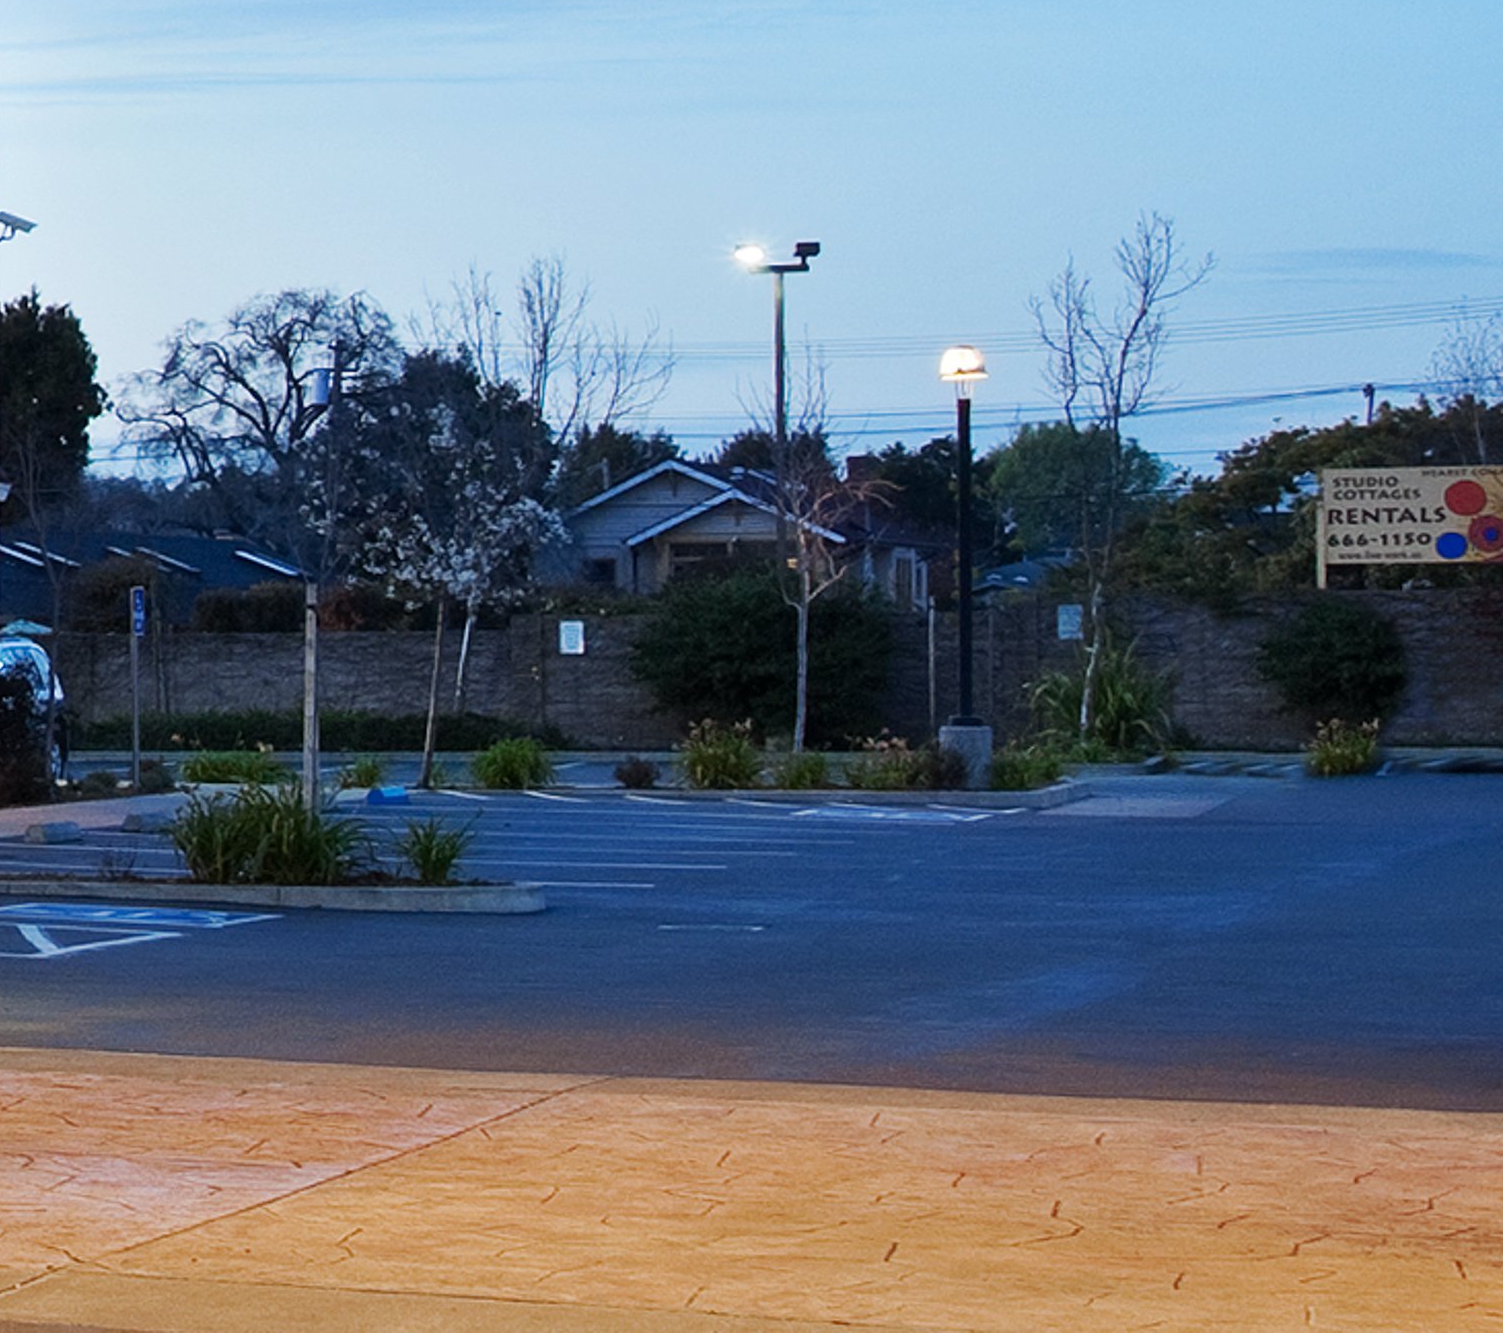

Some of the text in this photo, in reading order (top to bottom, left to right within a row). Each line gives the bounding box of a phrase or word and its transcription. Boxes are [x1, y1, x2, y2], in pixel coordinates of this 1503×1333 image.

[1332, 476, 1399, 487] STUDIO
[1333, 488, 1421, 501] COTTAGES
[1328, 506, 1448, 525] RENTALS
[1327, 533, 1431, 547] 666-1150
